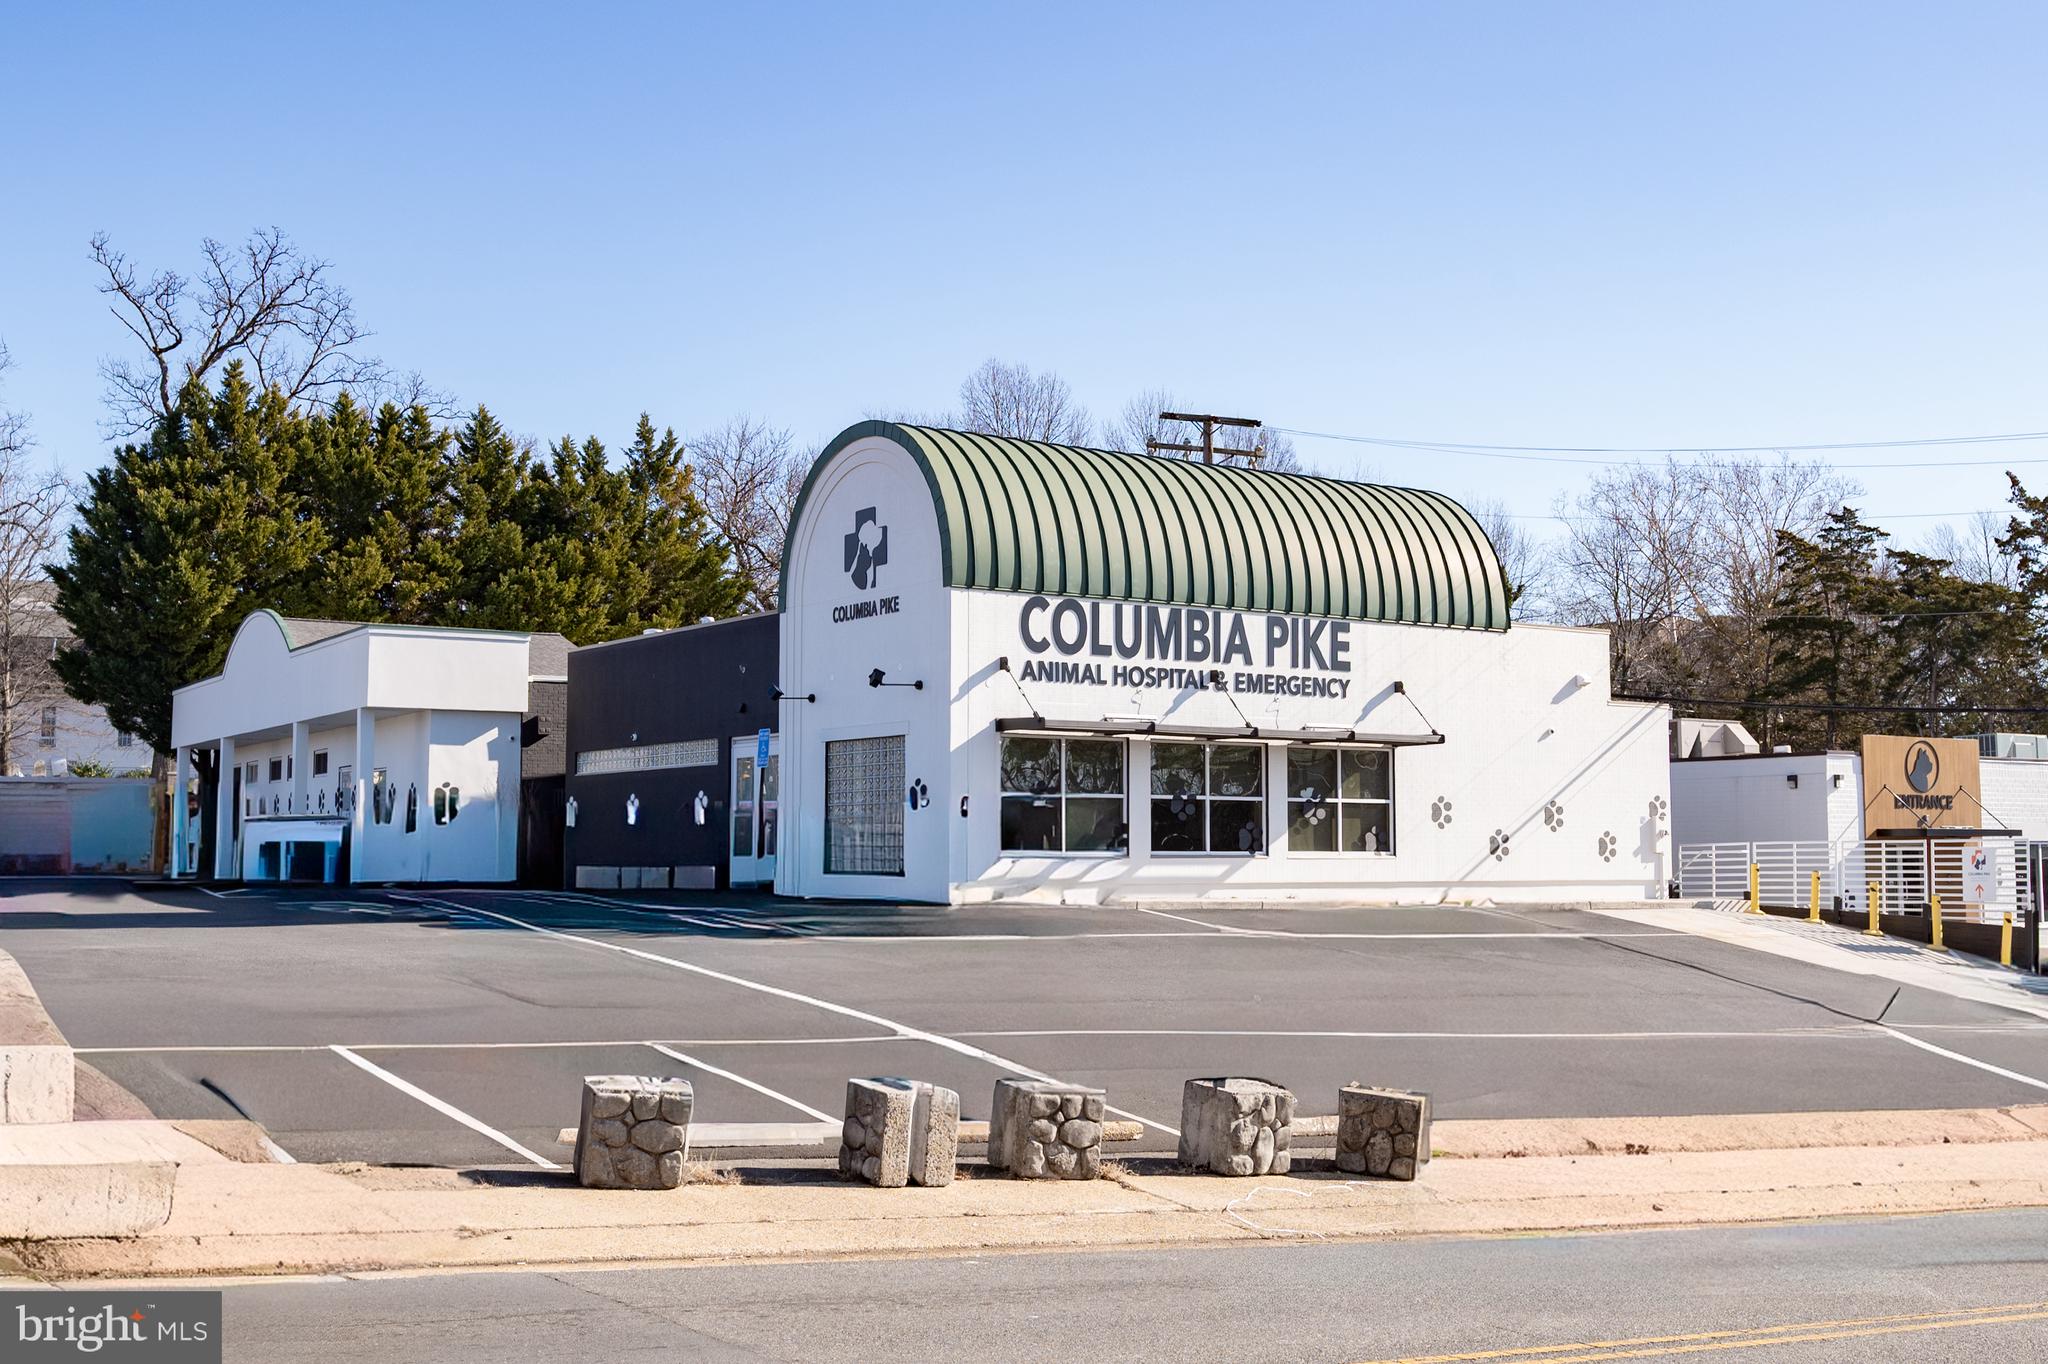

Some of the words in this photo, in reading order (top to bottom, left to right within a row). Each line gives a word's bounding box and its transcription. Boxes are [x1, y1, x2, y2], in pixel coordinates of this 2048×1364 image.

[832, 600, 878, 623] COLUMBIA
[879, 595, 900, 615] PIKE
[1020, 596, 1253, 667] COLUMBIA
[1266, 615, 1351, 673] PIKE
[1020, 660, 1108, 685] ANIMAL
[1112, 665, 1209, 690] HOSPITAL
[1234, 672, 1351, 699] EMERGENCY
[1894, 794, 1953, 810] ENTRANCE
